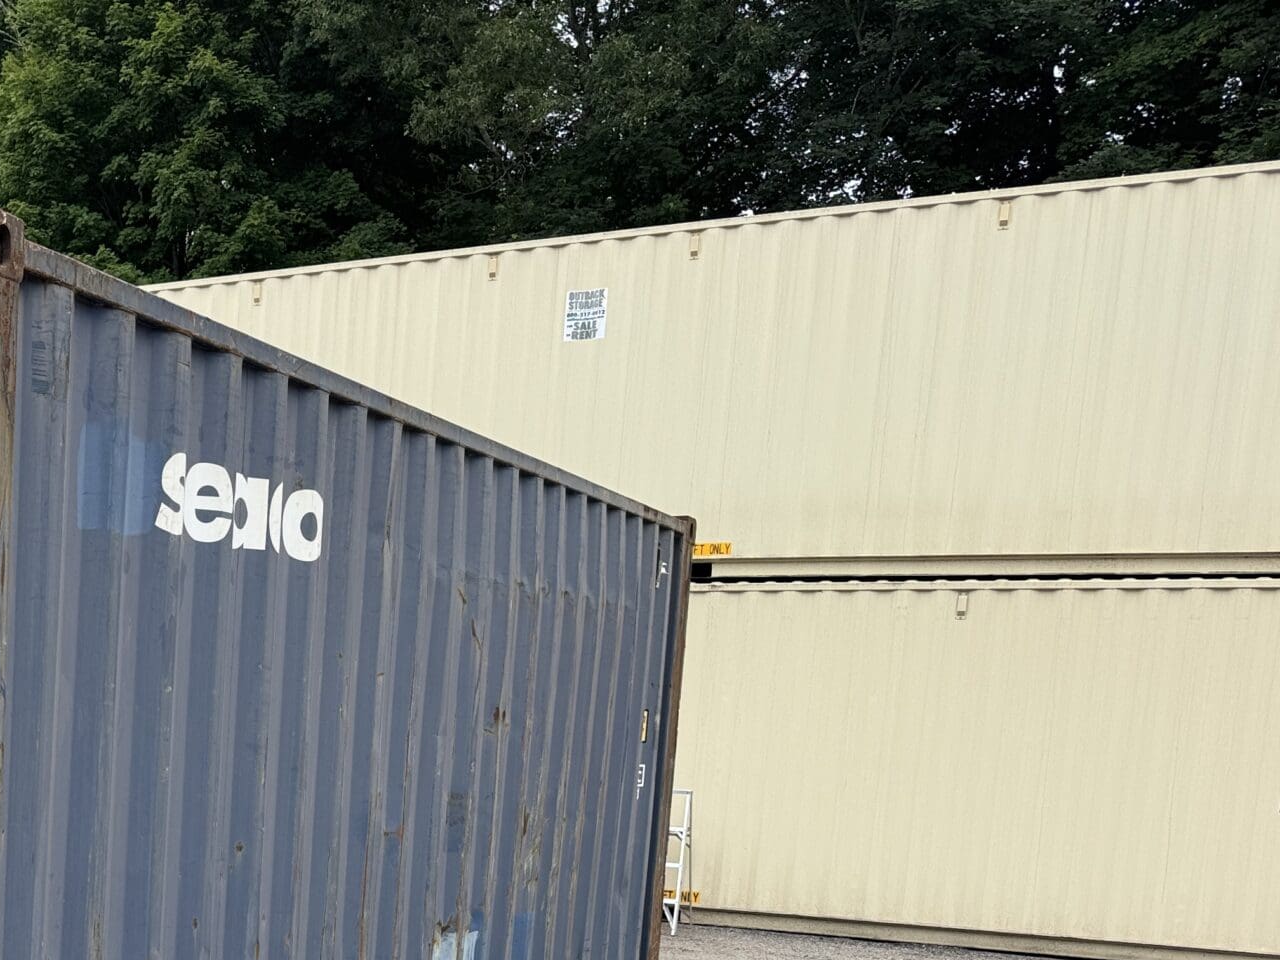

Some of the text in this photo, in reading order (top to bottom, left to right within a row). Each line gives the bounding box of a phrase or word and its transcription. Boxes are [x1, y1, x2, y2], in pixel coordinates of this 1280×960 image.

[569, 289, 605, 300] OUTBACK
[568, 299, 603, 310] STORAGE
[573, 321, 597, 330] SALE
[571, 330, 598, 340] RENT
[710, 543, 731, 555] ONLY
